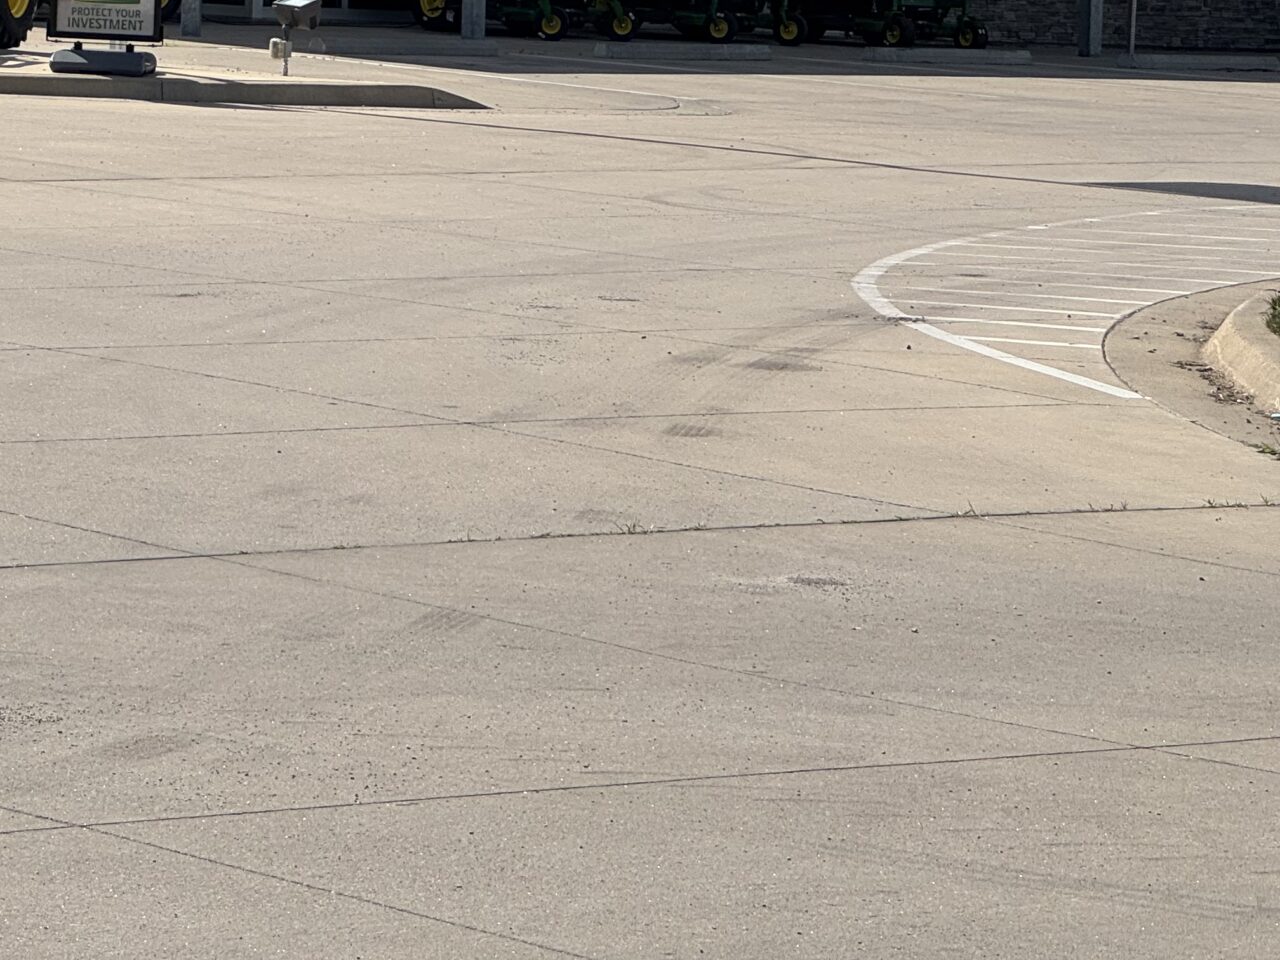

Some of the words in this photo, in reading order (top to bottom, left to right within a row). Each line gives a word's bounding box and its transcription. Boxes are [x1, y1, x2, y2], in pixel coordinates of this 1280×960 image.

[71, 7, 112, 18] PROTECT
[115, 8, 142, 19] YOUR
[67, 16, 145, 31] INVESTMENT
